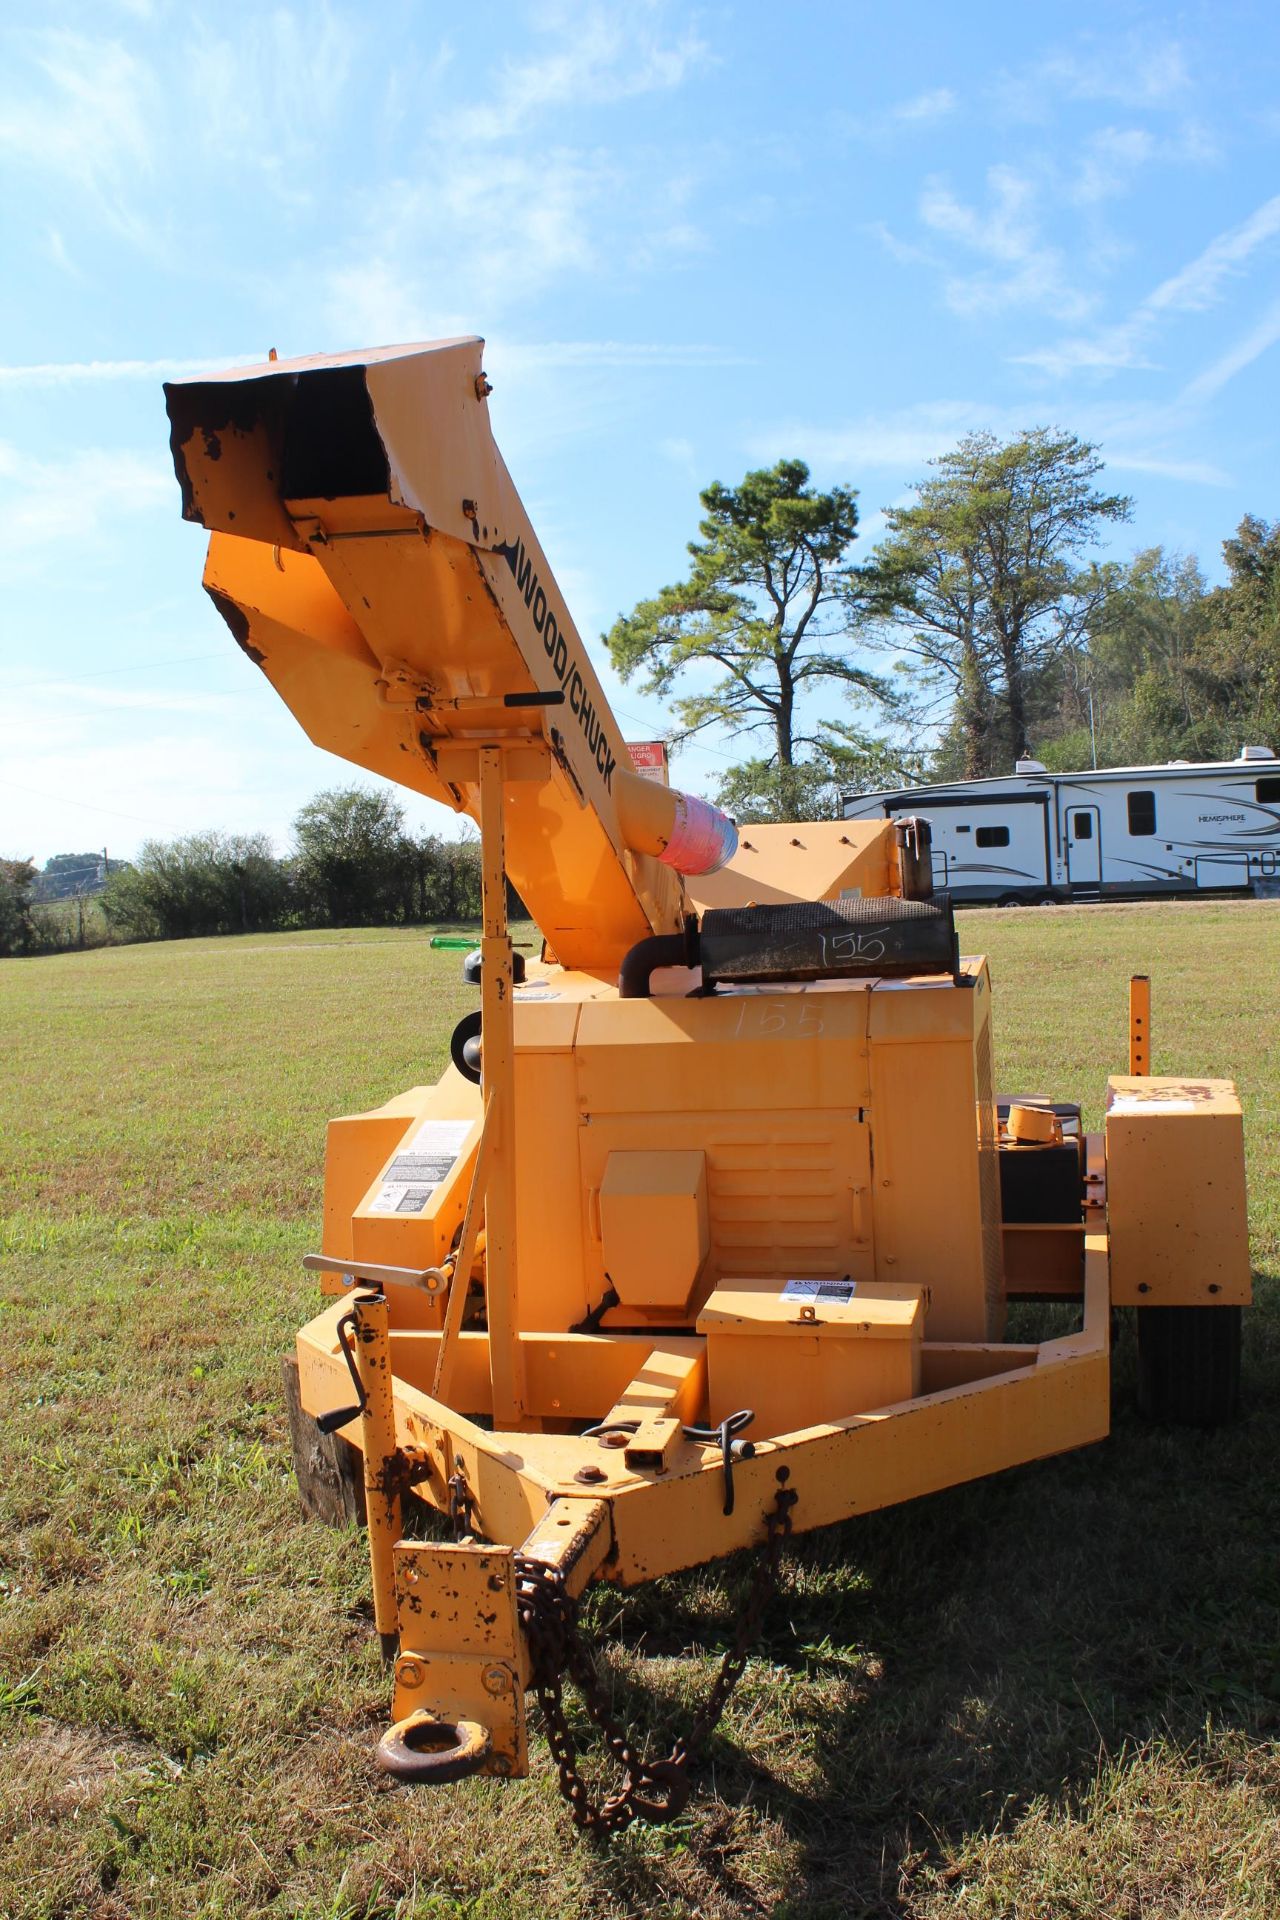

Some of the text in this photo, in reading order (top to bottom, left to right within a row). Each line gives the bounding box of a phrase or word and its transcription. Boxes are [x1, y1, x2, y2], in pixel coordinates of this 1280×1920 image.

[517, 543, 616, 797] WOOD/CHUCK
[1198, 814, 1246, 822] HEMISPHERE
[818, 927, 890, 967] 155
[735, 1001, 824, 1038] 155
